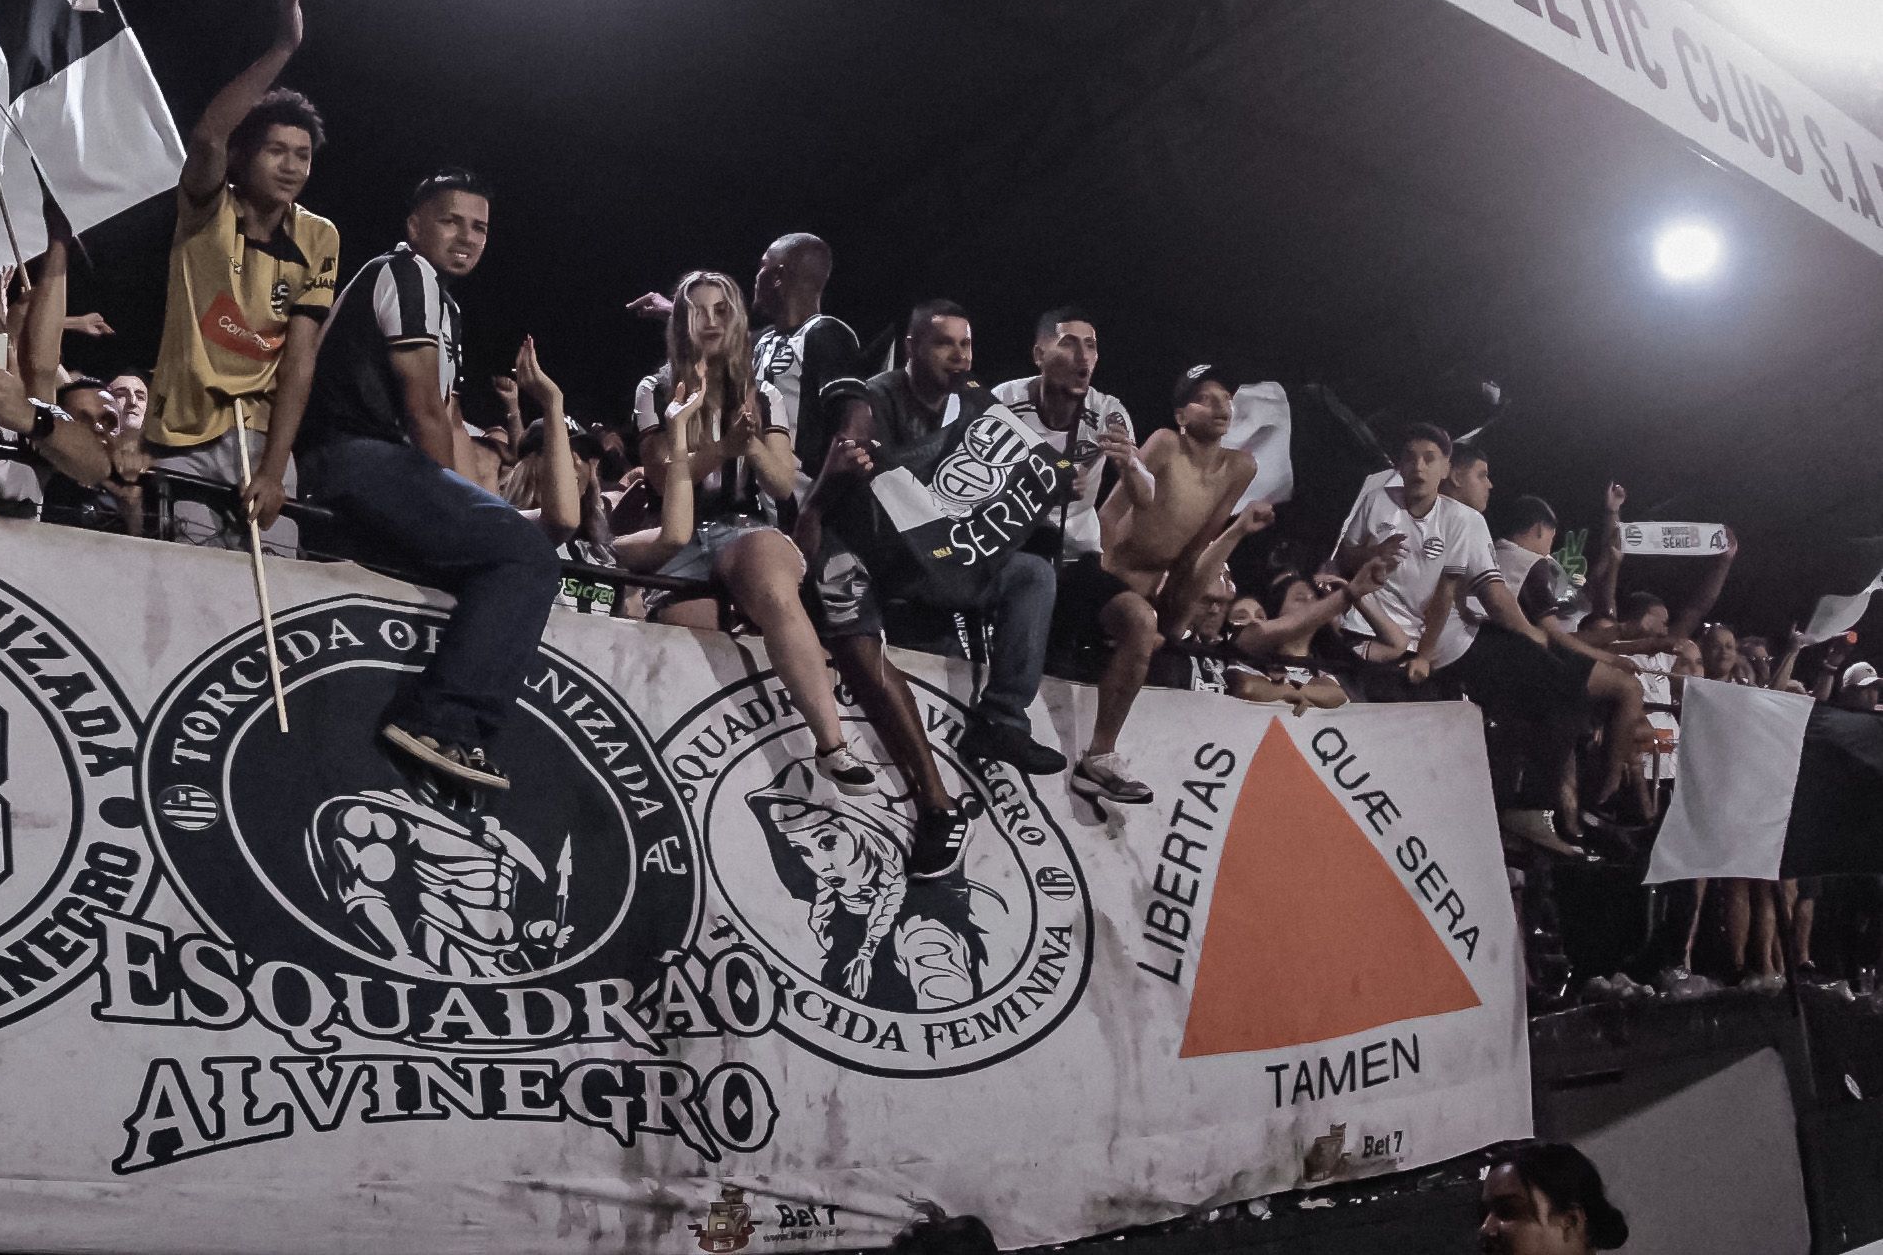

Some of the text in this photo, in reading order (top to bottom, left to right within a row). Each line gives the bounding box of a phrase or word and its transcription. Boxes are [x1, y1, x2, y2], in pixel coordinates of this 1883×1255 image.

[1672, 26, 1804, 176] CLUB
[1028, 453, 1057, 494] B
[170, 617, 365, 766] TORCIDA
[1135, 740, 1237, 985] LIBERTAS
[1395, 835, 1481, 963] SERA
[95, 914, 779, 1056] ESQUADRÃO
[919, 923, 1074, 1061] FEMININA
[113, 1055, 779, 1174] ALVINEGRO
[1264, 1032, 1420, 1108] TAMEN
[1362, 1130, 1404, 1159] Bet 7
